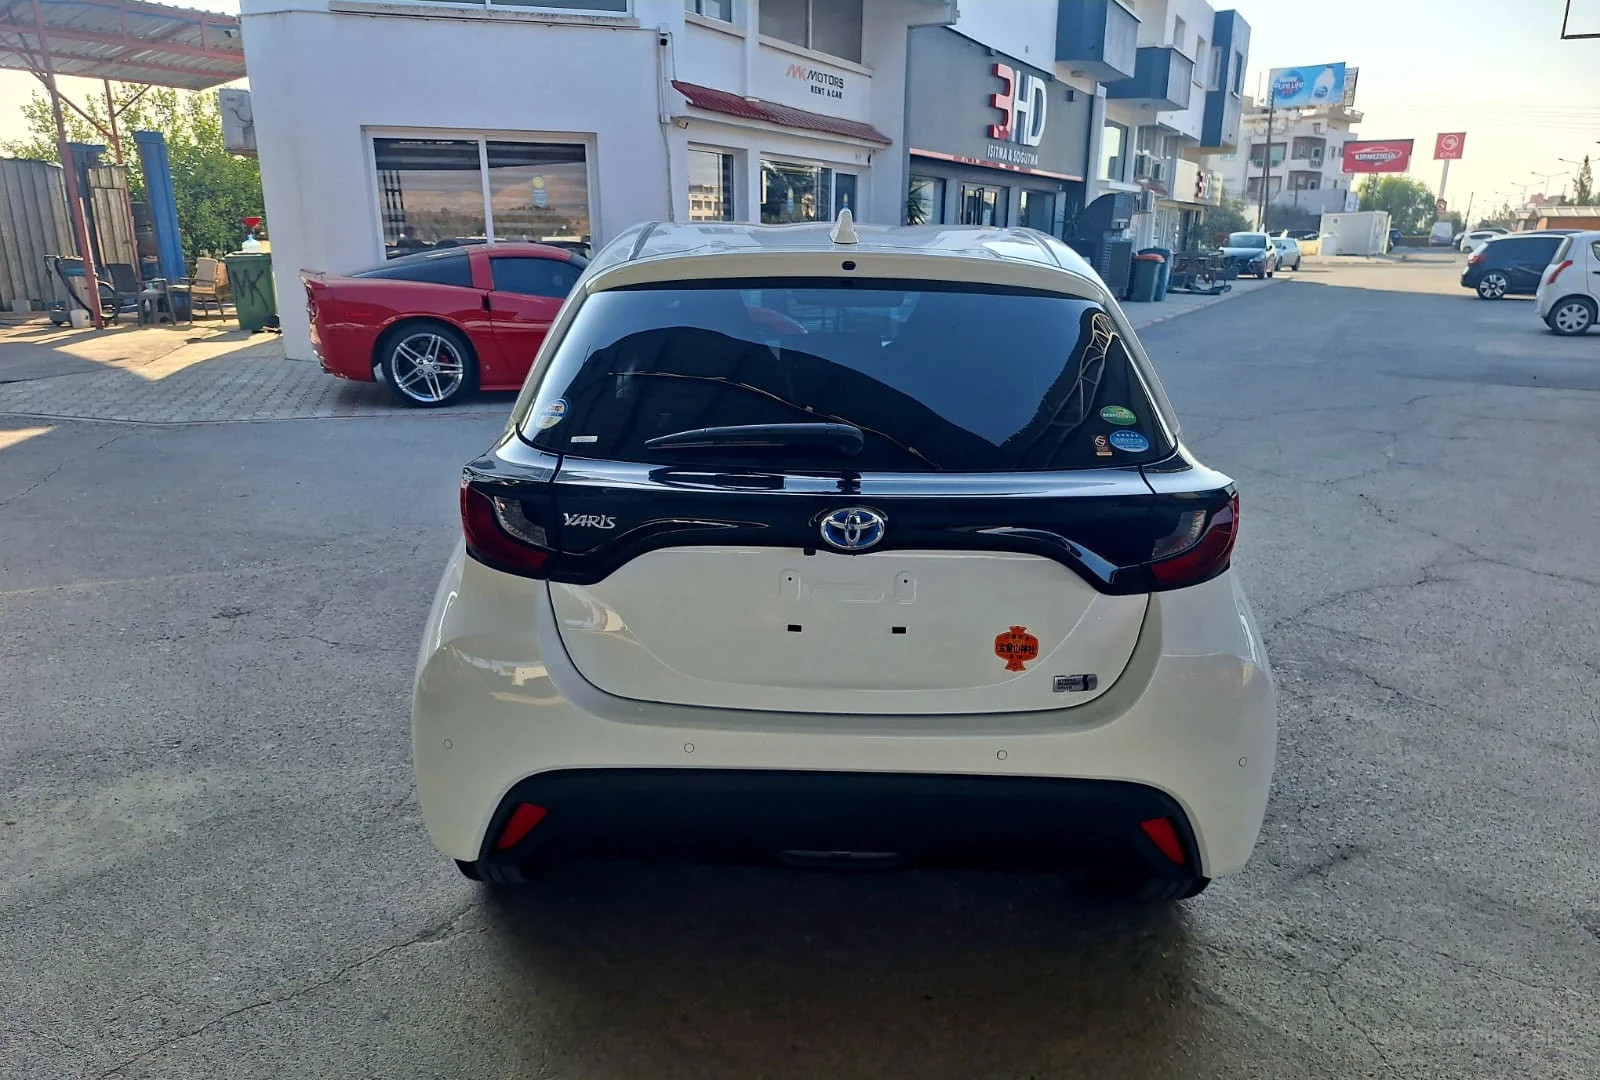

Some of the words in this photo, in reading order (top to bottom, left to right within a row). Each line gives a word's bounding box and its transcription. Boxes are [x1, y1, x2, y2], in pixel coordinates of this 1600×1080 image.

[807, 69, 844, 89] MOTORS
[810, 84, 825, 95] RENT
[827, 88, 831, 97] A
[832, 89, 843, 99] CAR
[233, 269, 269, 312] MK
[563, 512, 617, 529] YARIS
